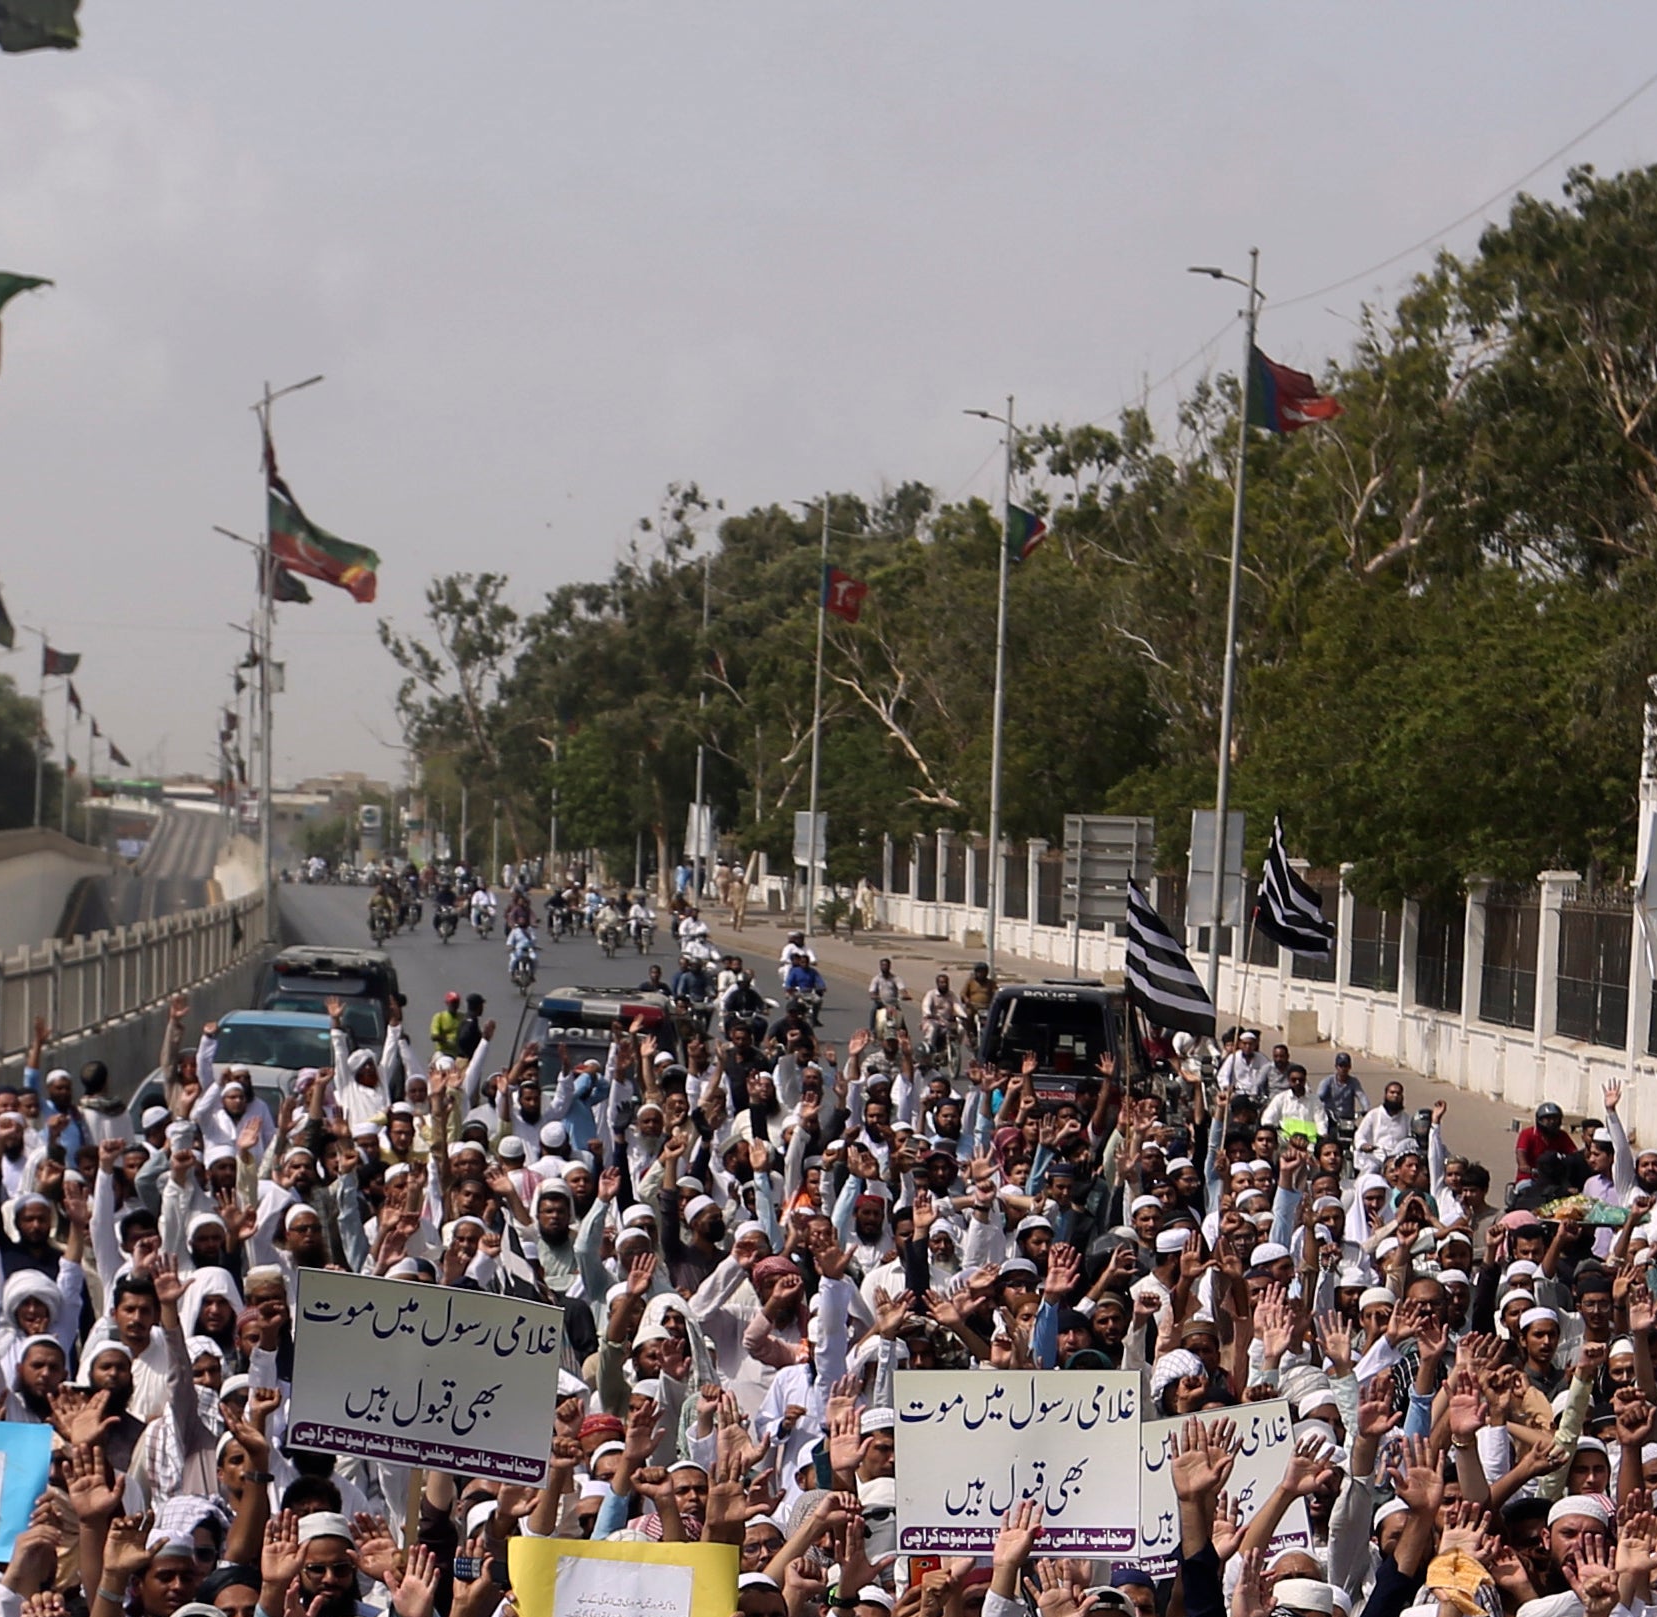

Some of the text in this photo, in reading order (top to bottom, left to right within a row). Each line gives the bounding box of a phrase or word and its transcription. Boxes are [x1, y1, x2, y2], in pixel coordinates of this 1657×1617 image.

[1024, 990, 1078, 1002] POLICE
[302, 1296, 556, 1357] غلامی رسول میں موت
[345, 1378, 503, 1436] بھی قبول ہیں
[899, 1376, 1135, 1430] غلامی رسول میں موت
[295, 1426, 335, 1446] کراچی
[335, 1428, 366, 1451] نبوت
[364, 1433, 391, 1453] ختم
[1240, 1416, 1288, 1456] غلامی
[419, 1446, 455, 1464] مجلس
[454, 1452, 491, 1469] عالمی
[945, 1472, 985, 1516] ہیں
[1044, 1457, 1089, 1516] بھی
[903, 1528, 941, 1548] کراچی
[940, 1528, 968, 1548] نبوت
[1052, 1528, 1086, 1548] عالمی
[1142, 1511, 1174, 1546] ہیں
